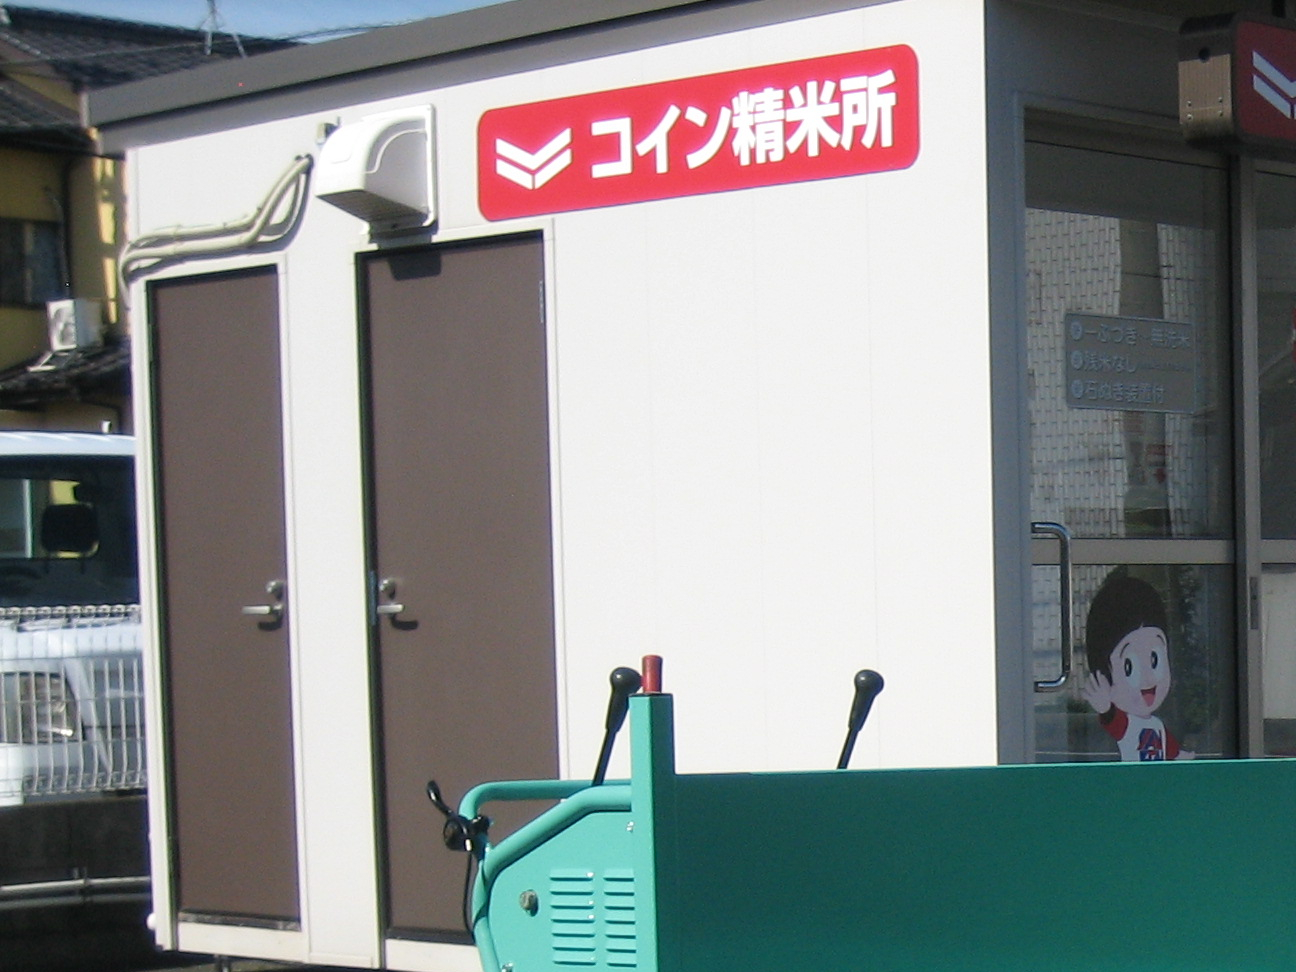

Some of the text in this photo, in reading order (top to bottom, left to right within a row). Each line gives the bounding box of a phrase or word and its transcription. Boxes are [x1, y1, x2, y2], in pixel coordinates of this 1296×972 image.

[591, 69, 897, 178] コイン精米所
